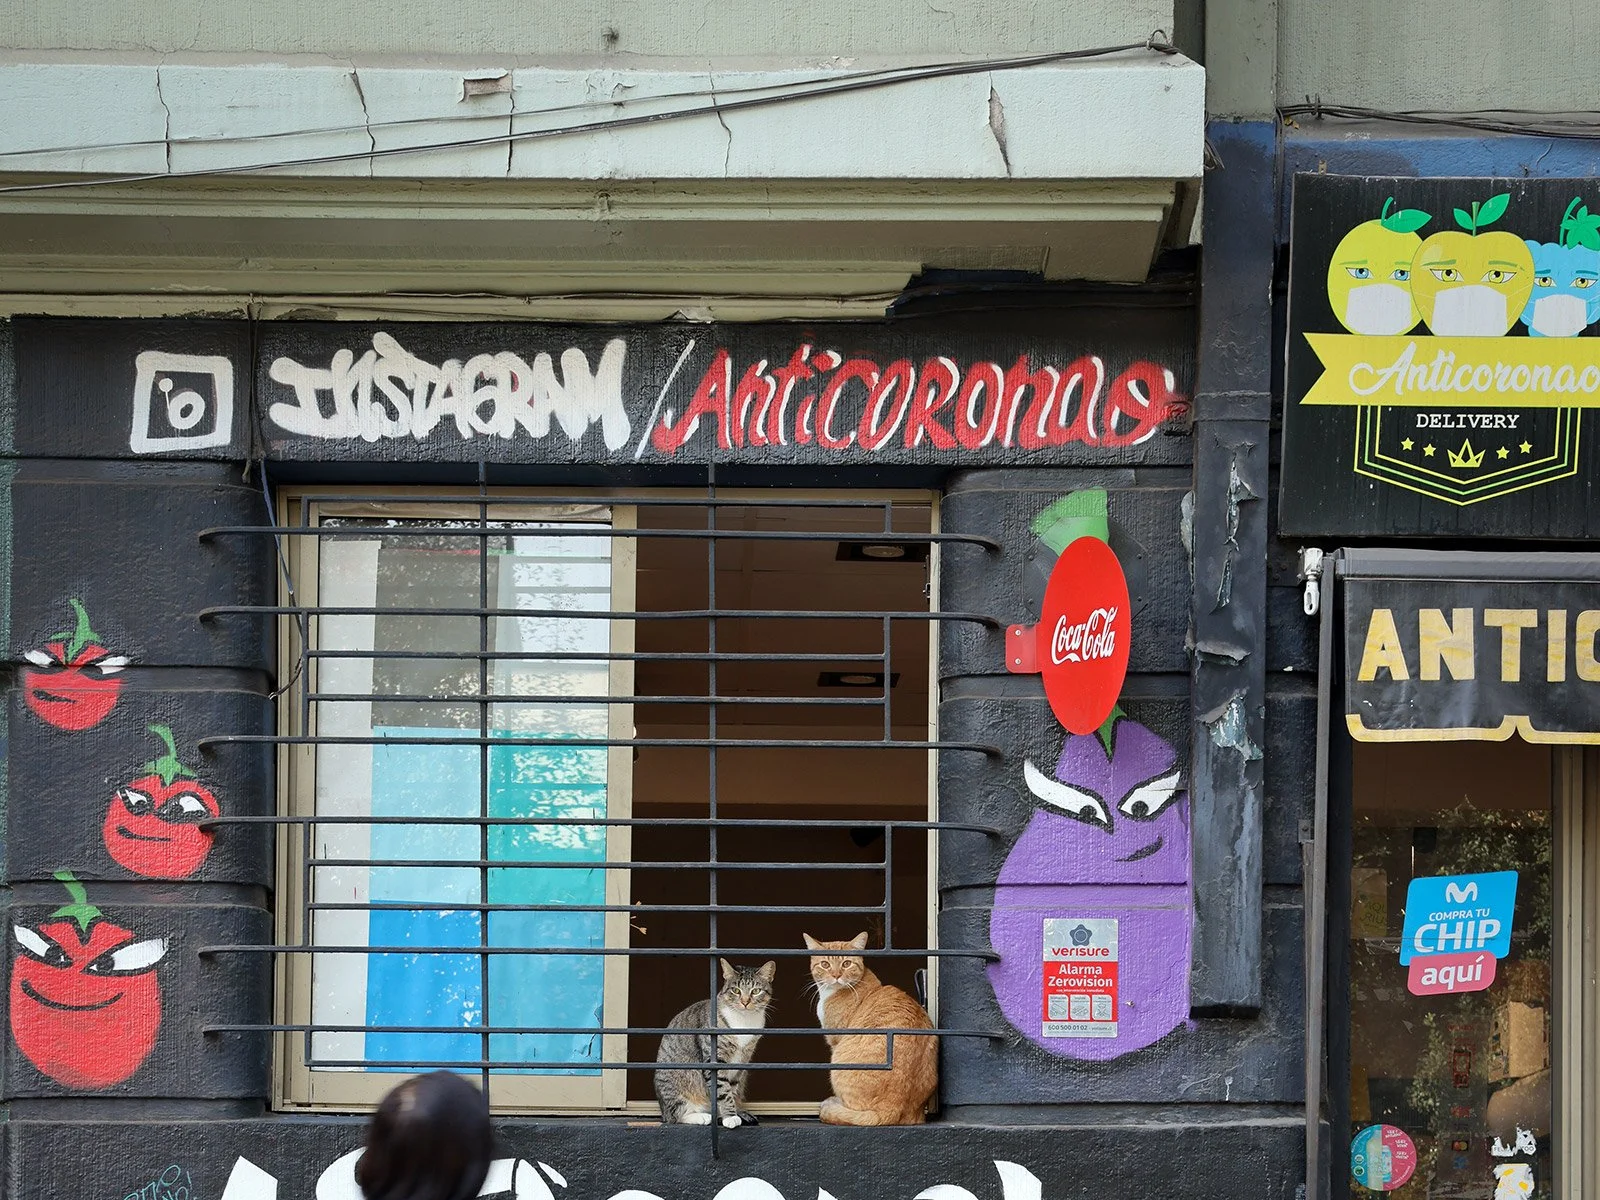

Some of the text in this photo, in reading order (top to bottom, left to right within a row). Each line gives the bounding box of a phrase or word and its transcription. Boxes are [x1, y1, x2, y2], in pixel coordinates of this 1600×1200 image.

[1348, 340, 1600, 396] Anticoronao
[1415, 413, 1520, 430] DELIVERY
[1051, 605, 1119, 665] Coca-Cola
[1428, 908, 1491, 922] COMPRA TU
[1413, 919, 1501, 953] CHIP
[1051, 947, 1110, 957] verisure
[1058, 963, 1103, 975] Alarma
[1421, 954, 1485, 991] aquí
[1047, 975, 1113, 987] Zerovision
